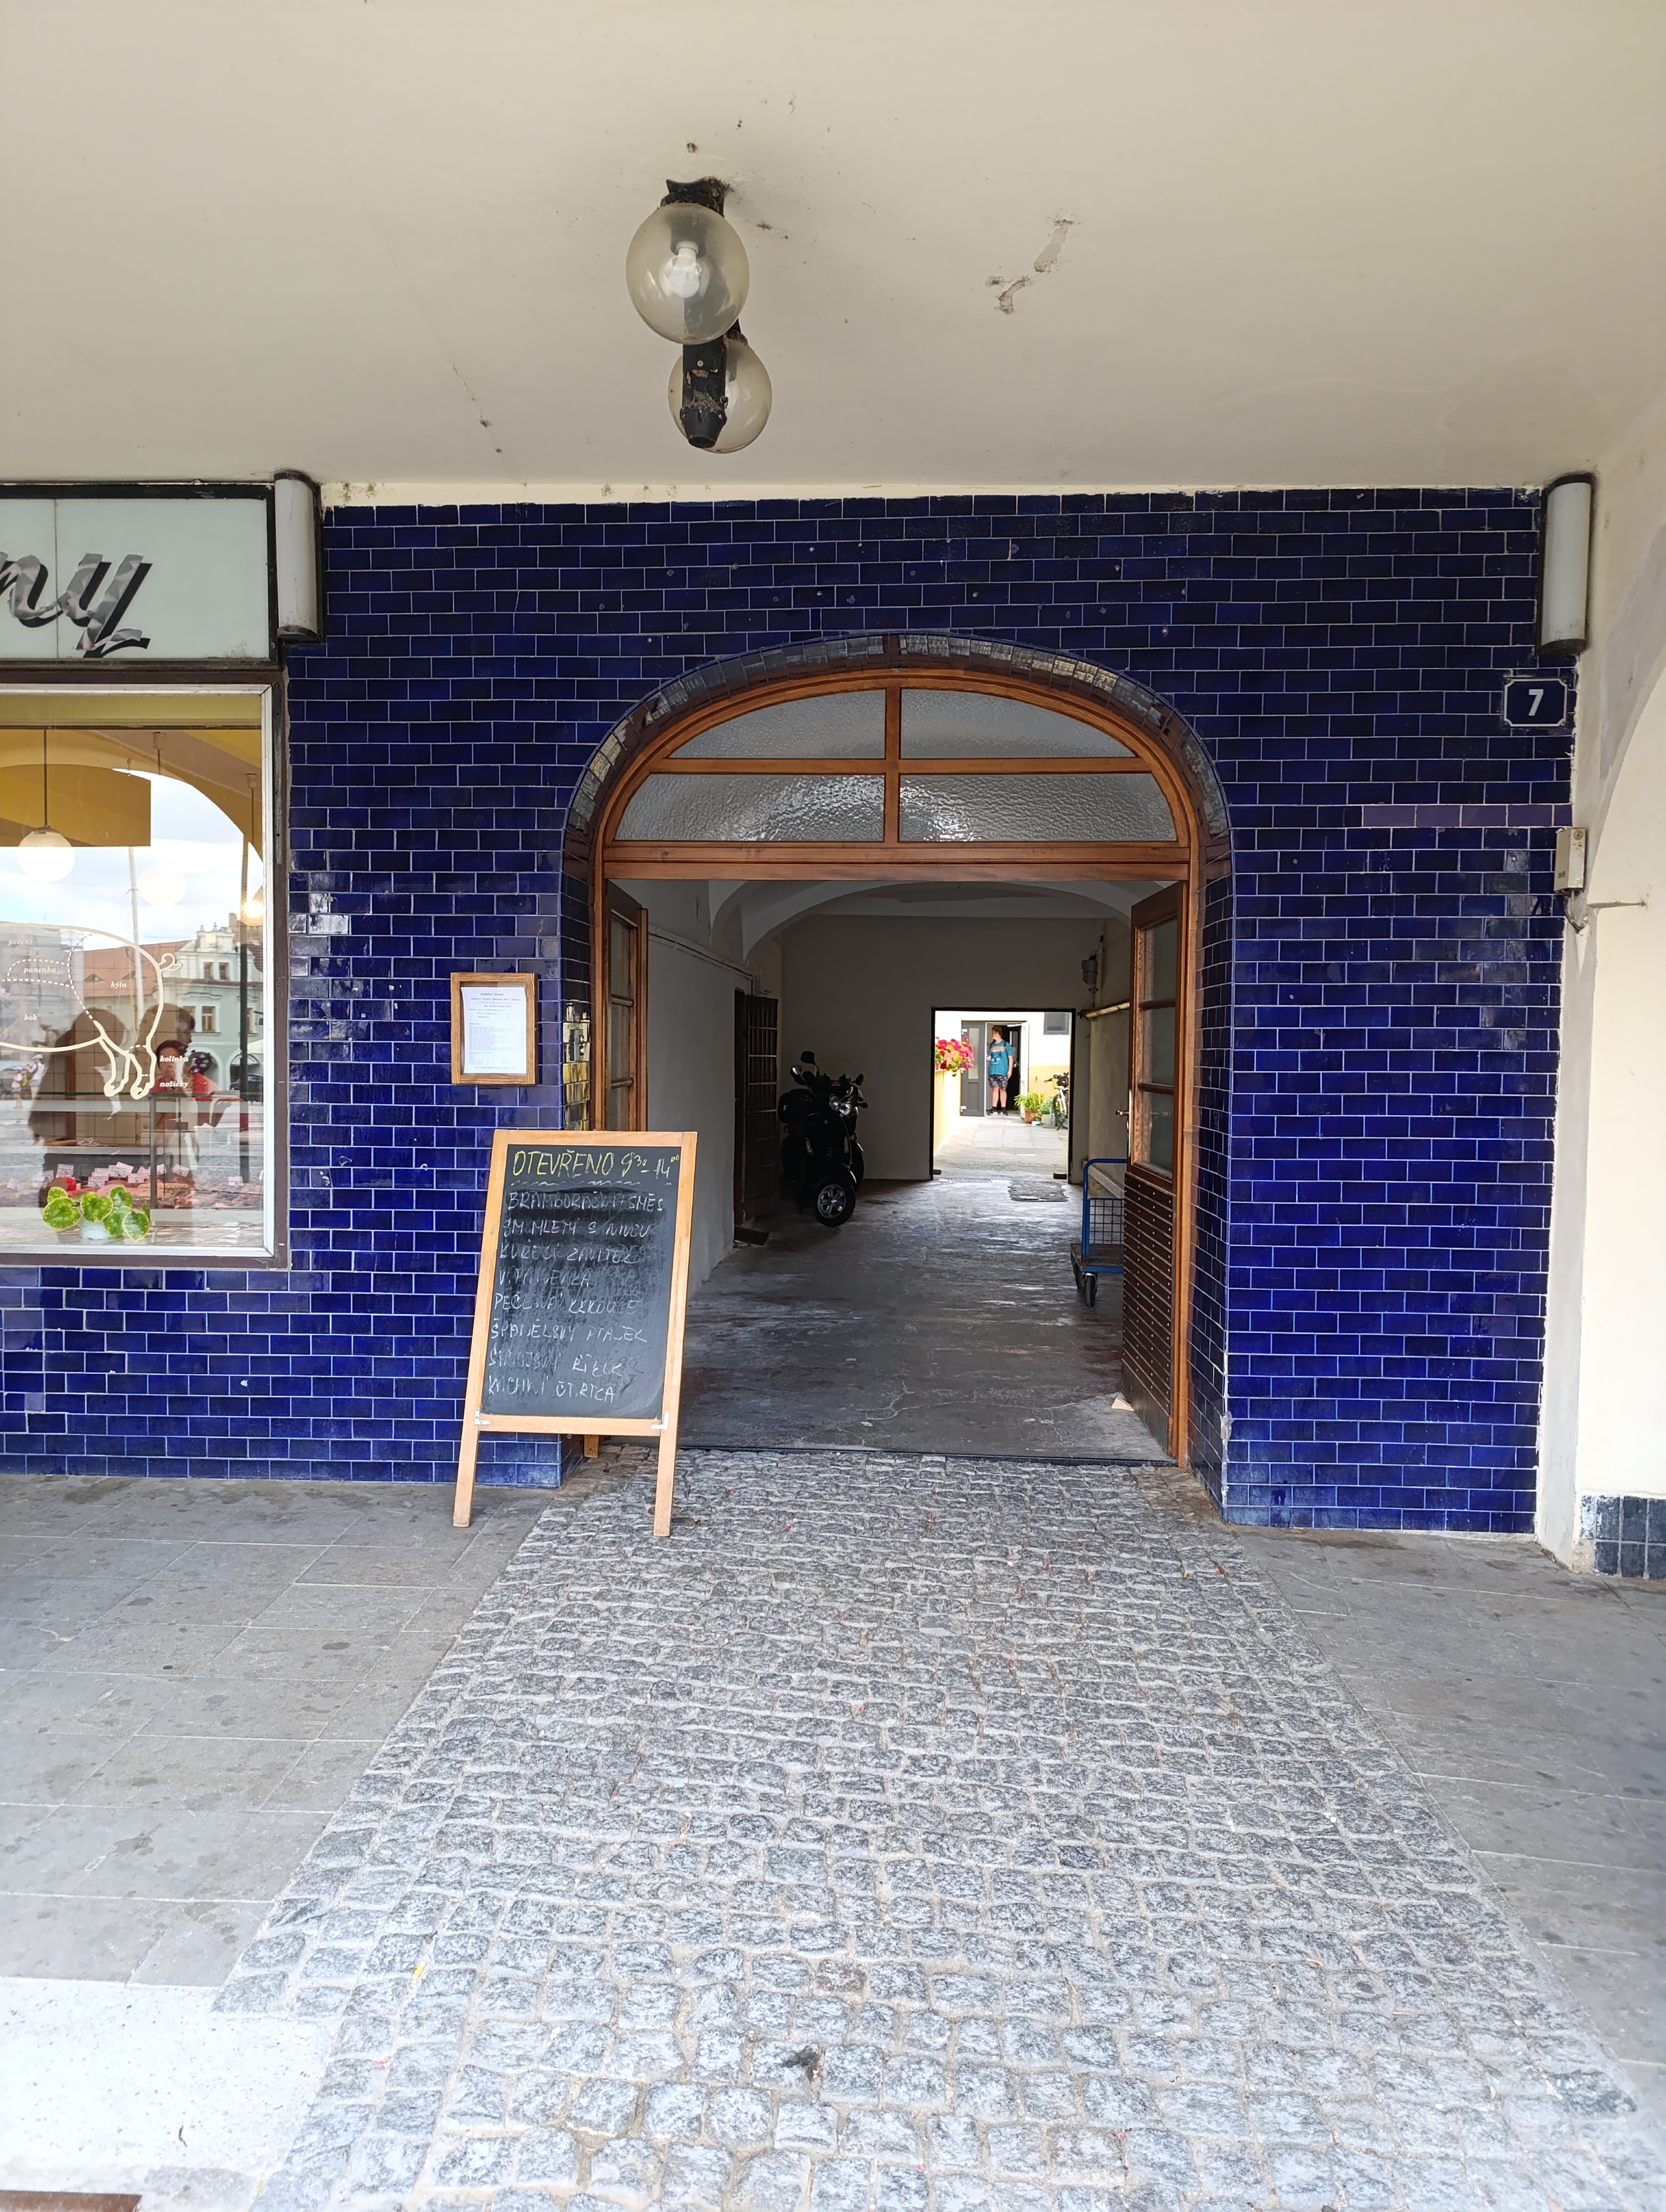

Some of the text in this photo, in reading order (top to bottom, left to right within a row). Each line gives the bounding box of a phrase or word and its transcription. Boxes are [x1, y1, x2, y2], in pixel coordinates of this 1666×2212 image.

[1528, 689, 1545, 716] 7
[23, 966, 56, 974] panenka
[513, 1149, 614, 1178] OTEVŘENO
